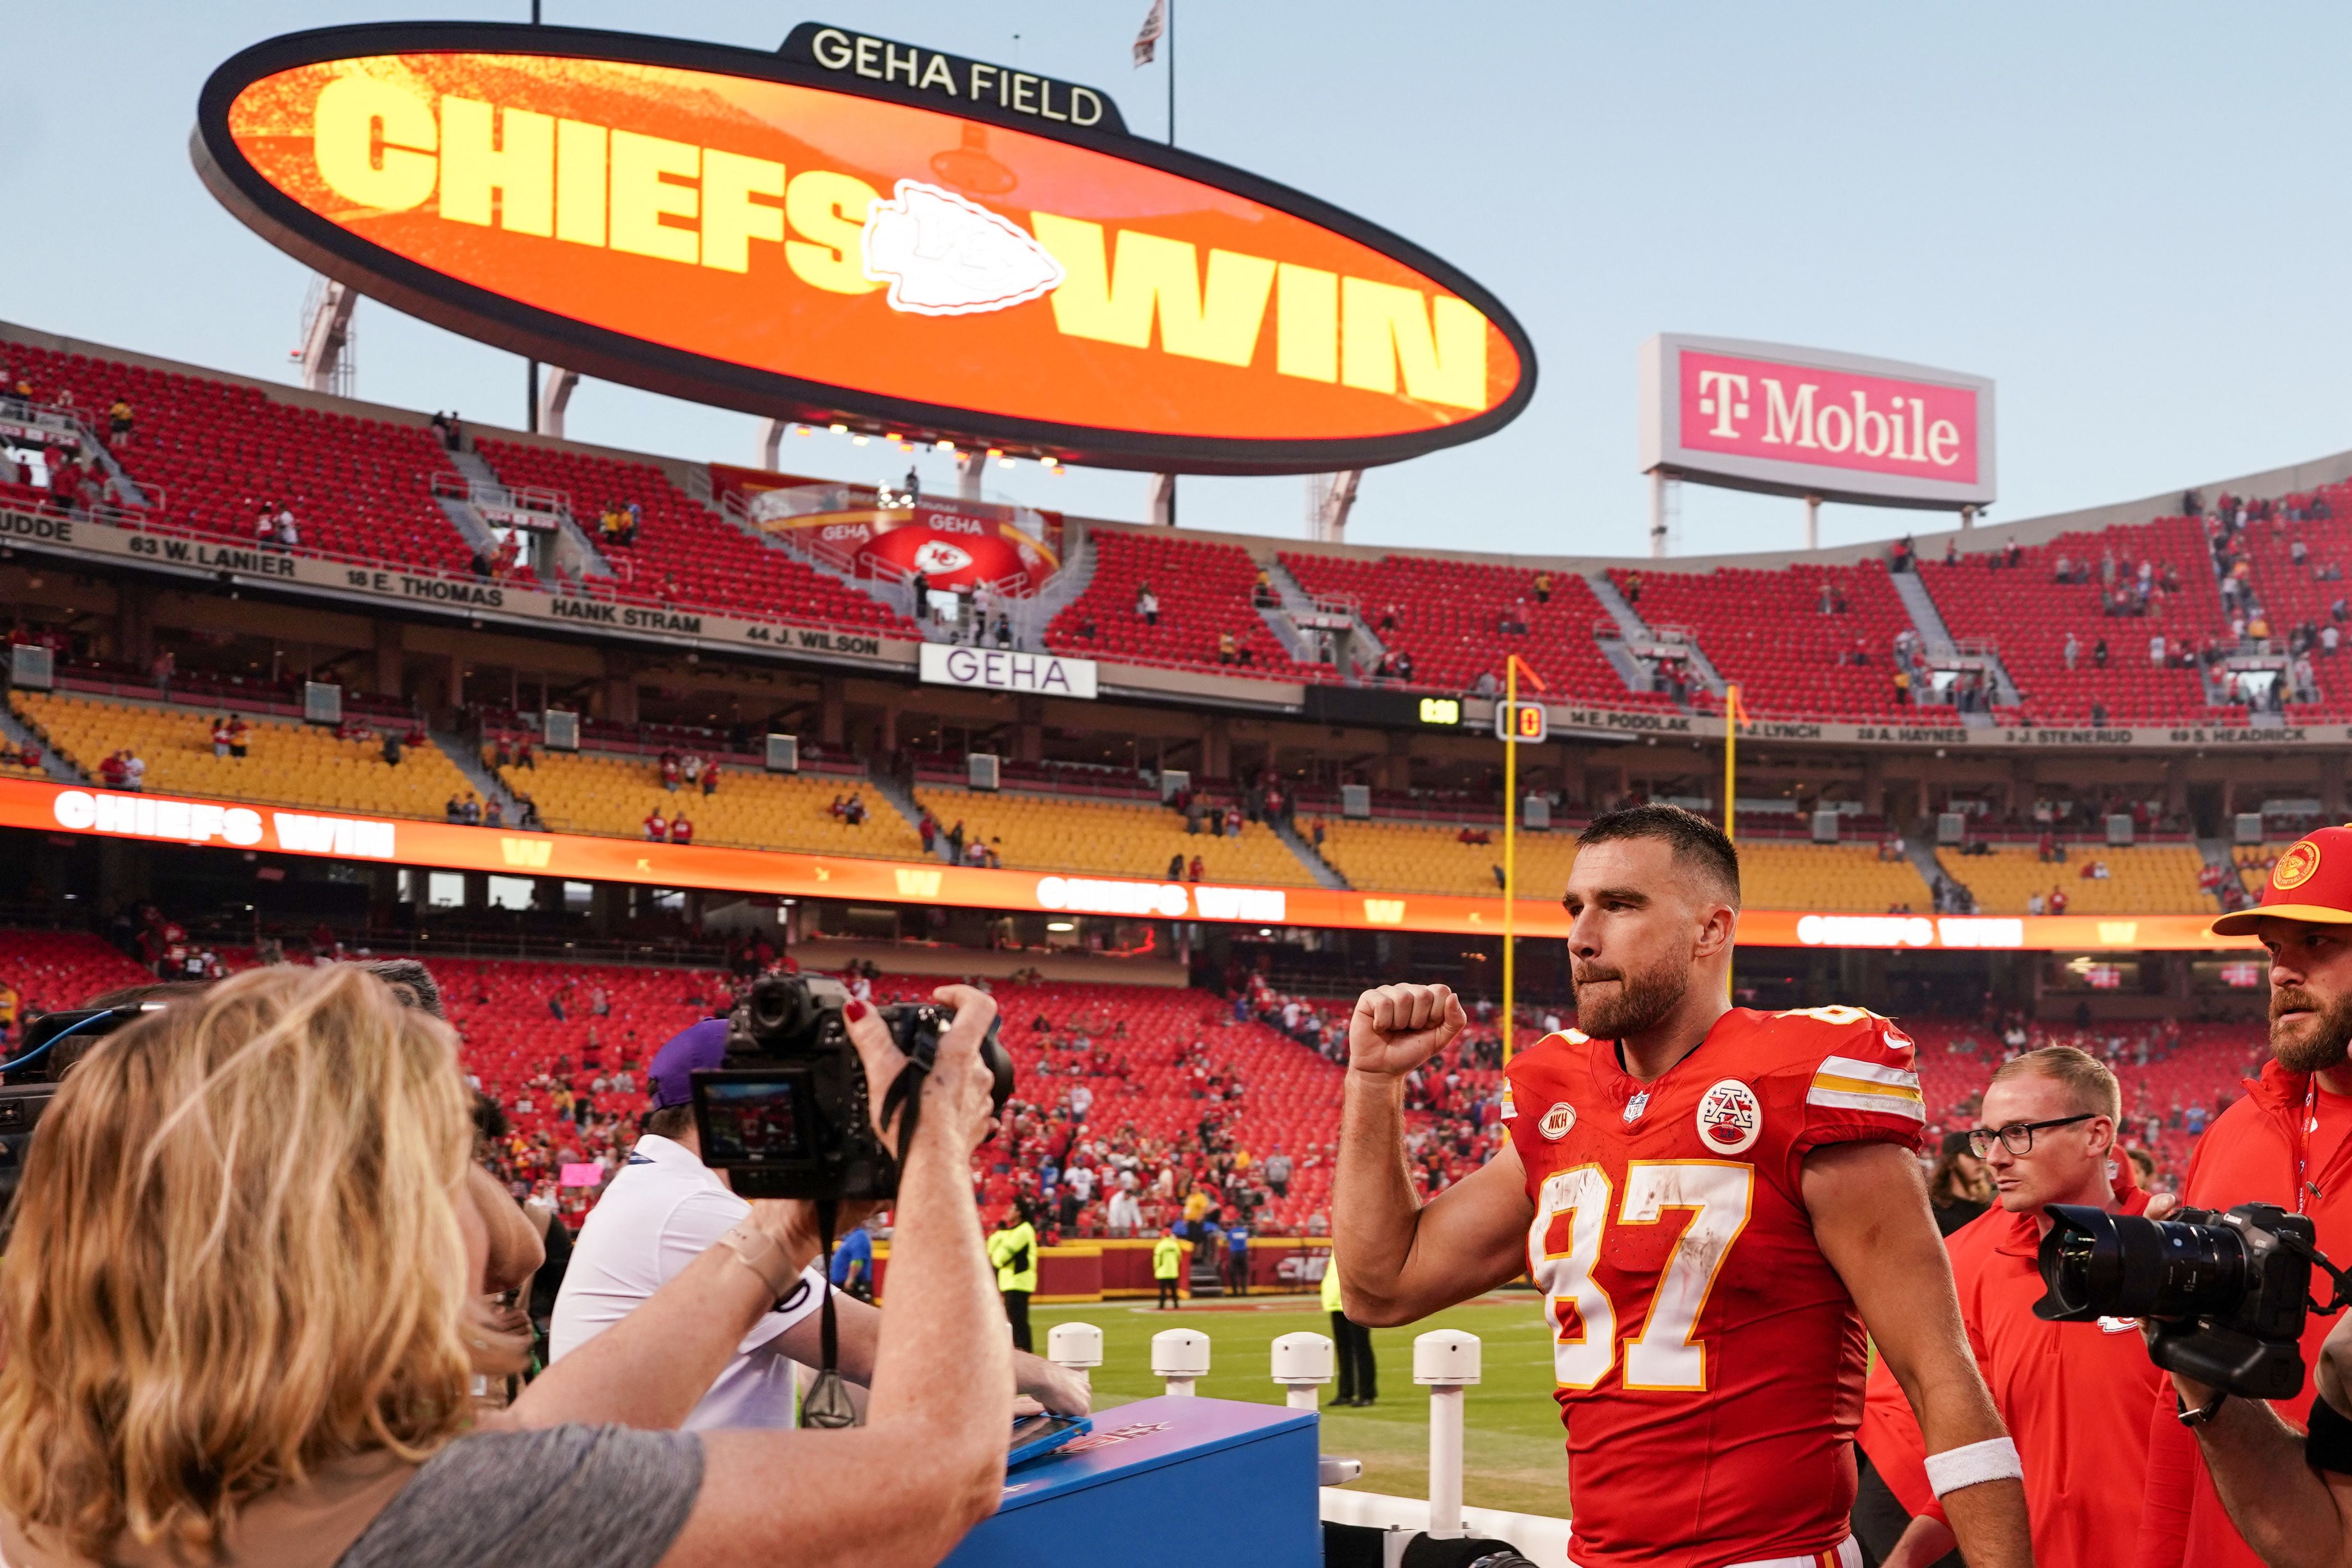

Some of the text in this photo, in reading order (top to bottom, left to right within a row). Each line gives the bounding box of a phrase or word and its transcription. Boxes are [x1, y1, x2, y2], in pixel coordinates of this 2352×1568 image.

[812, 29, 1103, 127] GEHA FIELD
[313, 75, 1487, 412] CHIEFS WIN
[1699, 370, 1960, 466] T Mobile
[822, 522, 871, 542] GEHA
[928, 513, 984, 536] GEHA
[129, 536, 295, 577] 63 W. LANIER
[347, 569, 504, 607] 18 E. THOMAS
[551, 597, 702, 633] HANK STRAM
[746, 626, 880, 656] 44 J. WILSON
[947, 647, 1071, 693] GEHA
[1607, 713, 1691, 732] PODOLAK
[1763, 723, 1821, 738] LYNCH
[1898, 727, 1968, 743] HAYNES
[2038, 729, 2132, 743] STENERUD
[53, 790, 396, 858] CHIEFS WIN
[501, 837, 554, 869] W
[894, 869, 943, 897] W
[1363, 899, 1407, 924] W
[2097, 921, 2138, 945] W
[1548, 1112, 1568, 1130] NKH
[1626, 1104, 1643, 1117] NFL
[1704, 1087, 1753, 1129] A
[1527, 1159, 1755, 1392] 87
